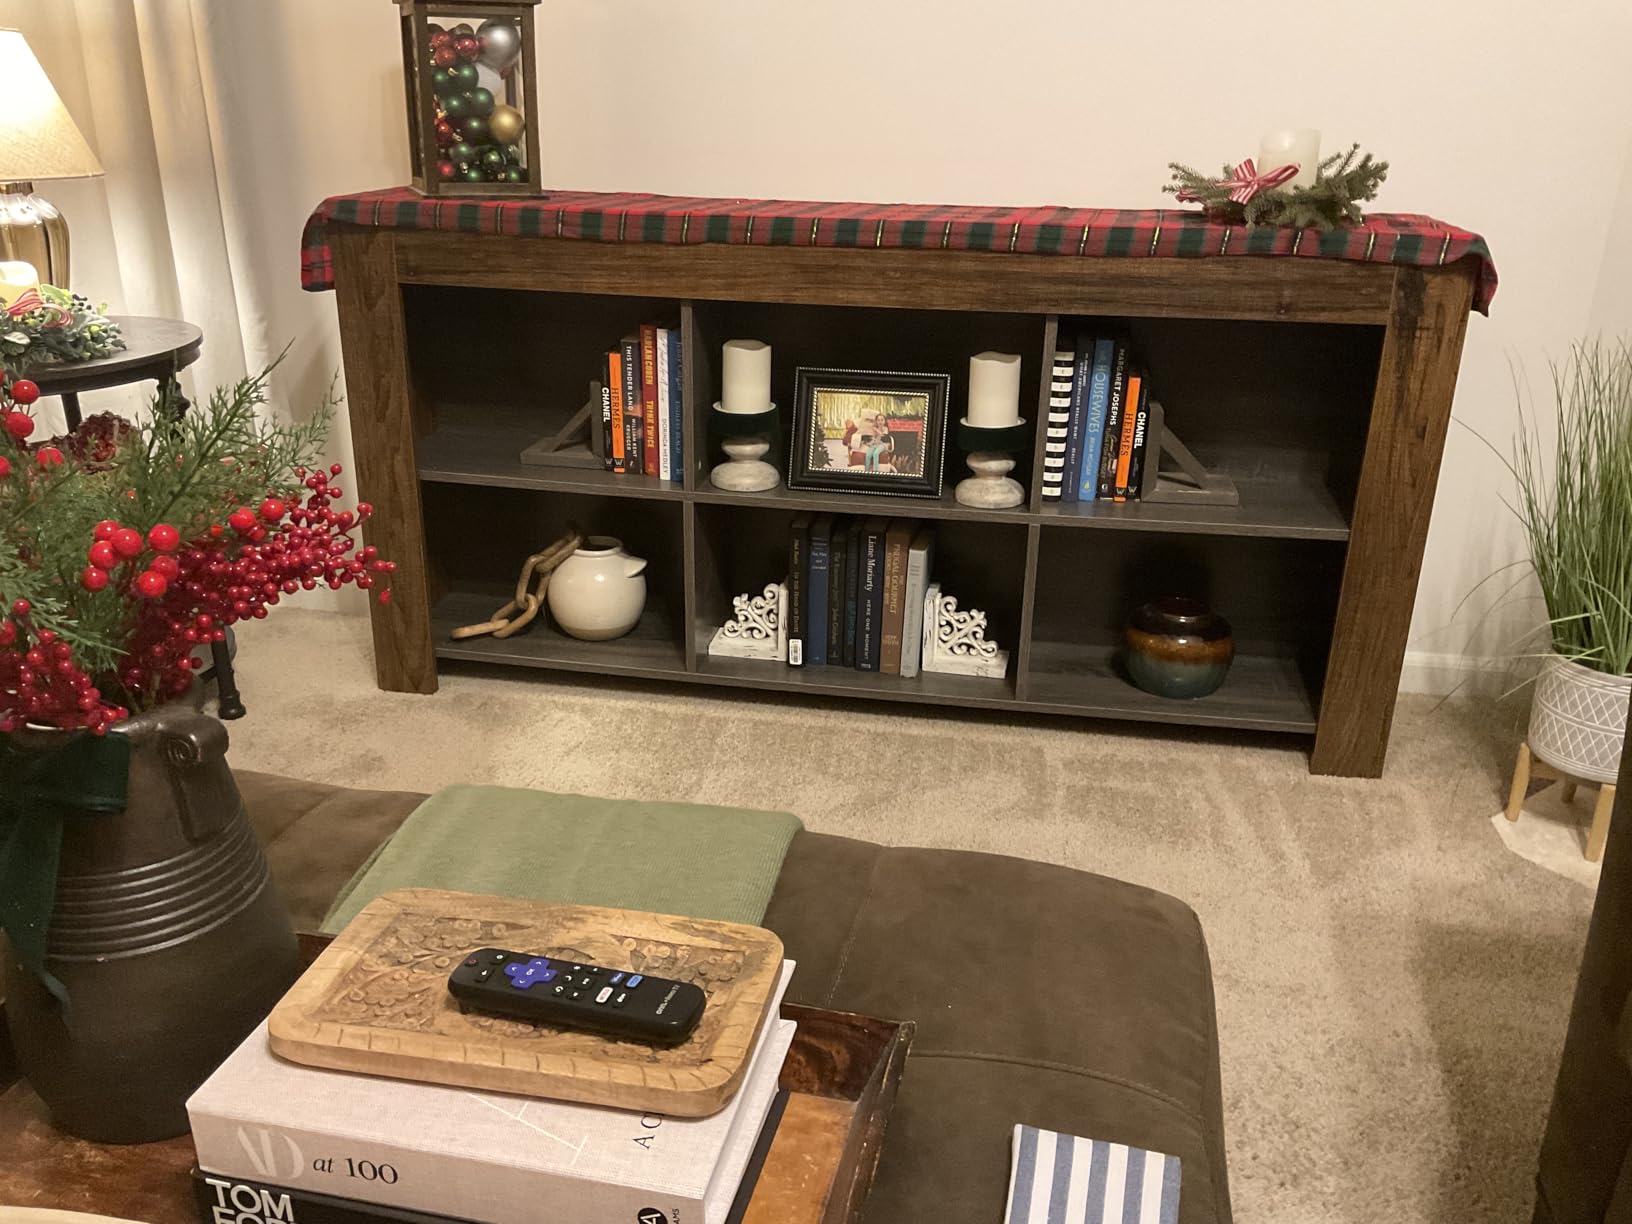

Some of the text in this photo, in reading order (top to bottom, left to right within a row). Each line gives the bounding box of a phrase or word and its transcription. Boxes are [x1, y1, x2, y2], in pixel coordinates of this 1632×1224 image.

[644, 330, 653, 384] HARLAN COBEN
[1114, 349, 1125, 390] MARGARET
[602, 387, 610, 422] CHANEL
[646, 400, 654, 423] THINK
[1088, 365, 1107, 432] HOUSEWIVES
[1110, 392, 1120, 425] JOSEPHS
[1134, 412, 1146, 448] CHANEL
[864, 535, 877, 592] Liane Moriarty
[632, 1135, 655, 1149] A
[313, 1158, 335, 1174] at
[344, 1158, 398, 1185] 100
[205, 1178, 294, 1222] TOM
